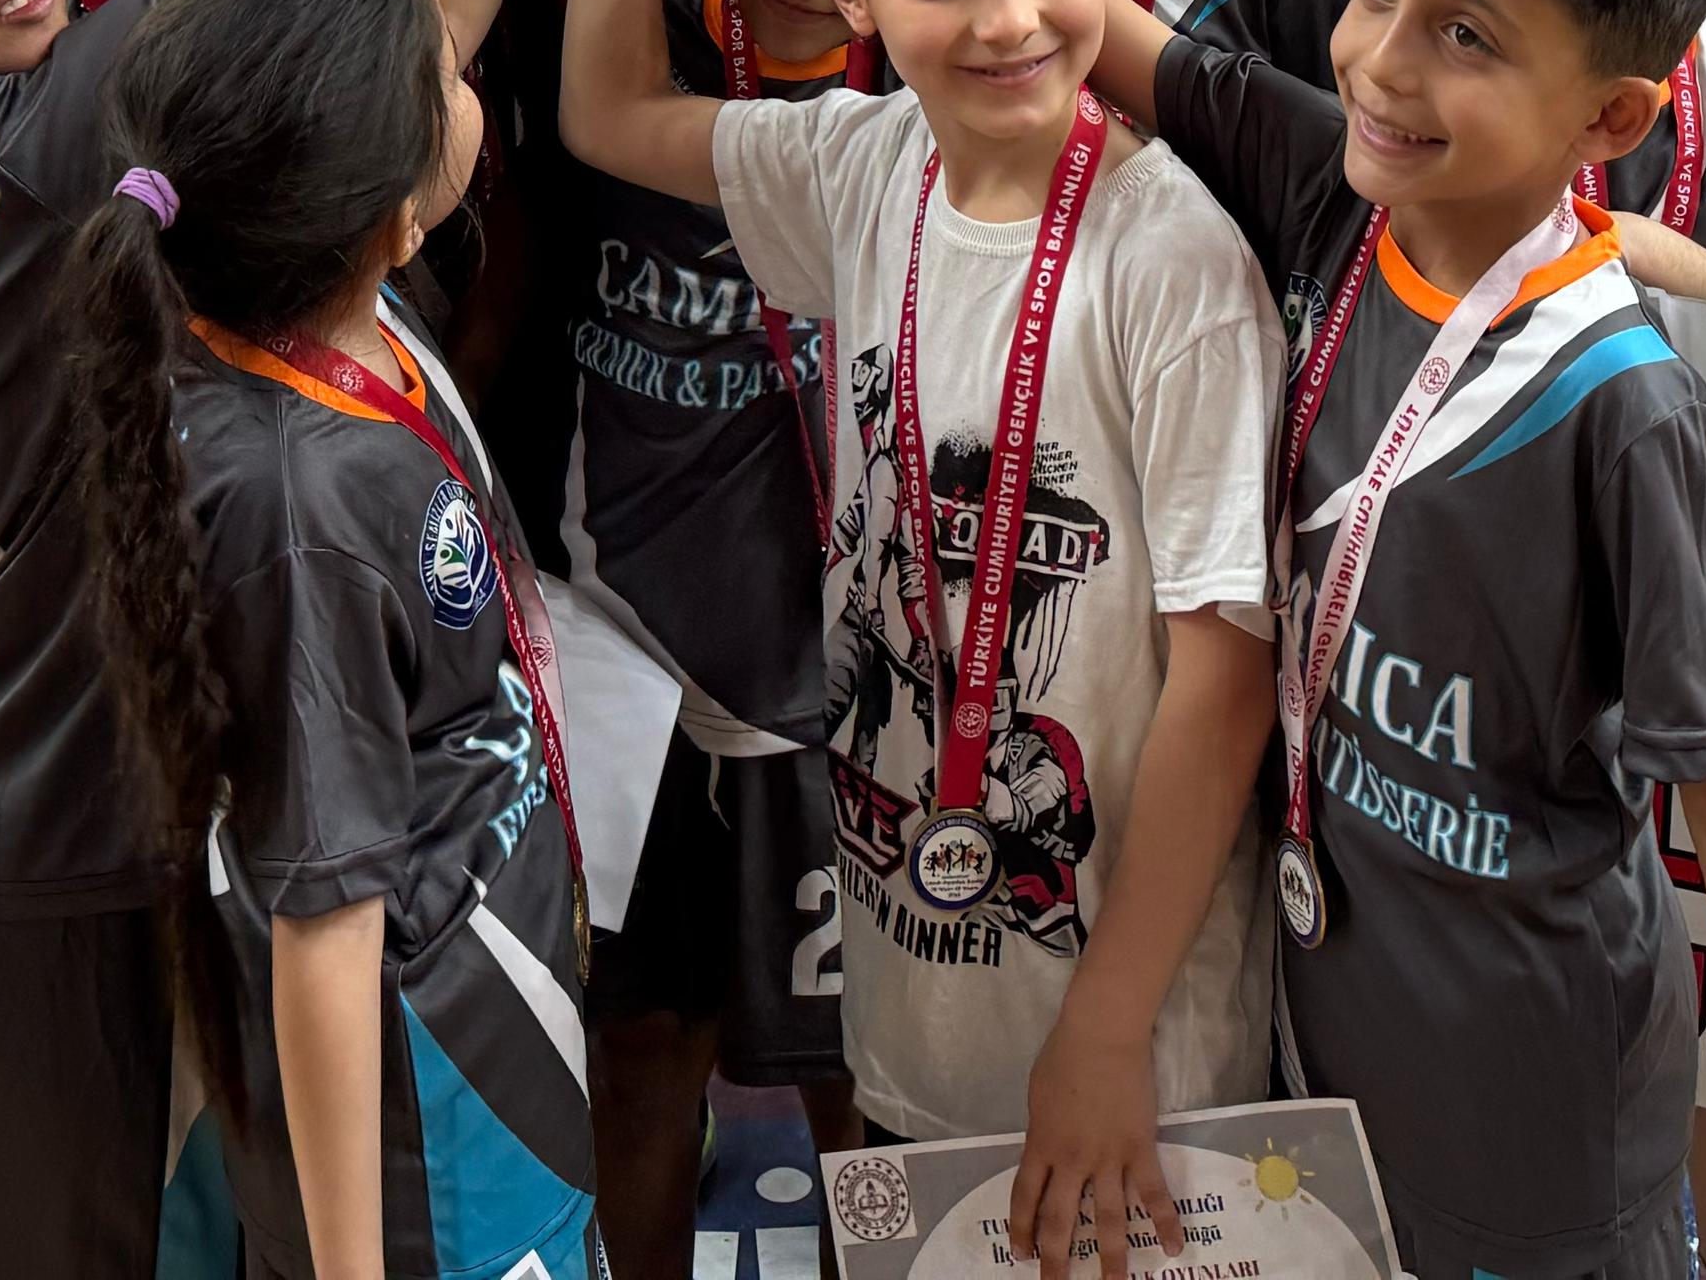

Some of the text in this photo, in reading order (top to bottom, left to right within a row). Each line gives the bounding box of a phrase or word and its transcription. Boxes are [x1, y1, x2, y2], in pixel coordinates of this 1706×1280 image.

[1678, 162, 1694, 183] VE
[1671, 183, 1691, 228] SPOR
[1310, 243, 1368, 387] CUMHURİYETİ
[903, 419, 917, 446] VE
[969, 142, 1093, 688] TÜRKİYE CUMHURİYETİ GENÇLİK VE SPOR BAKANLIĞI
[893, 903, 1003, 968] DINNER
